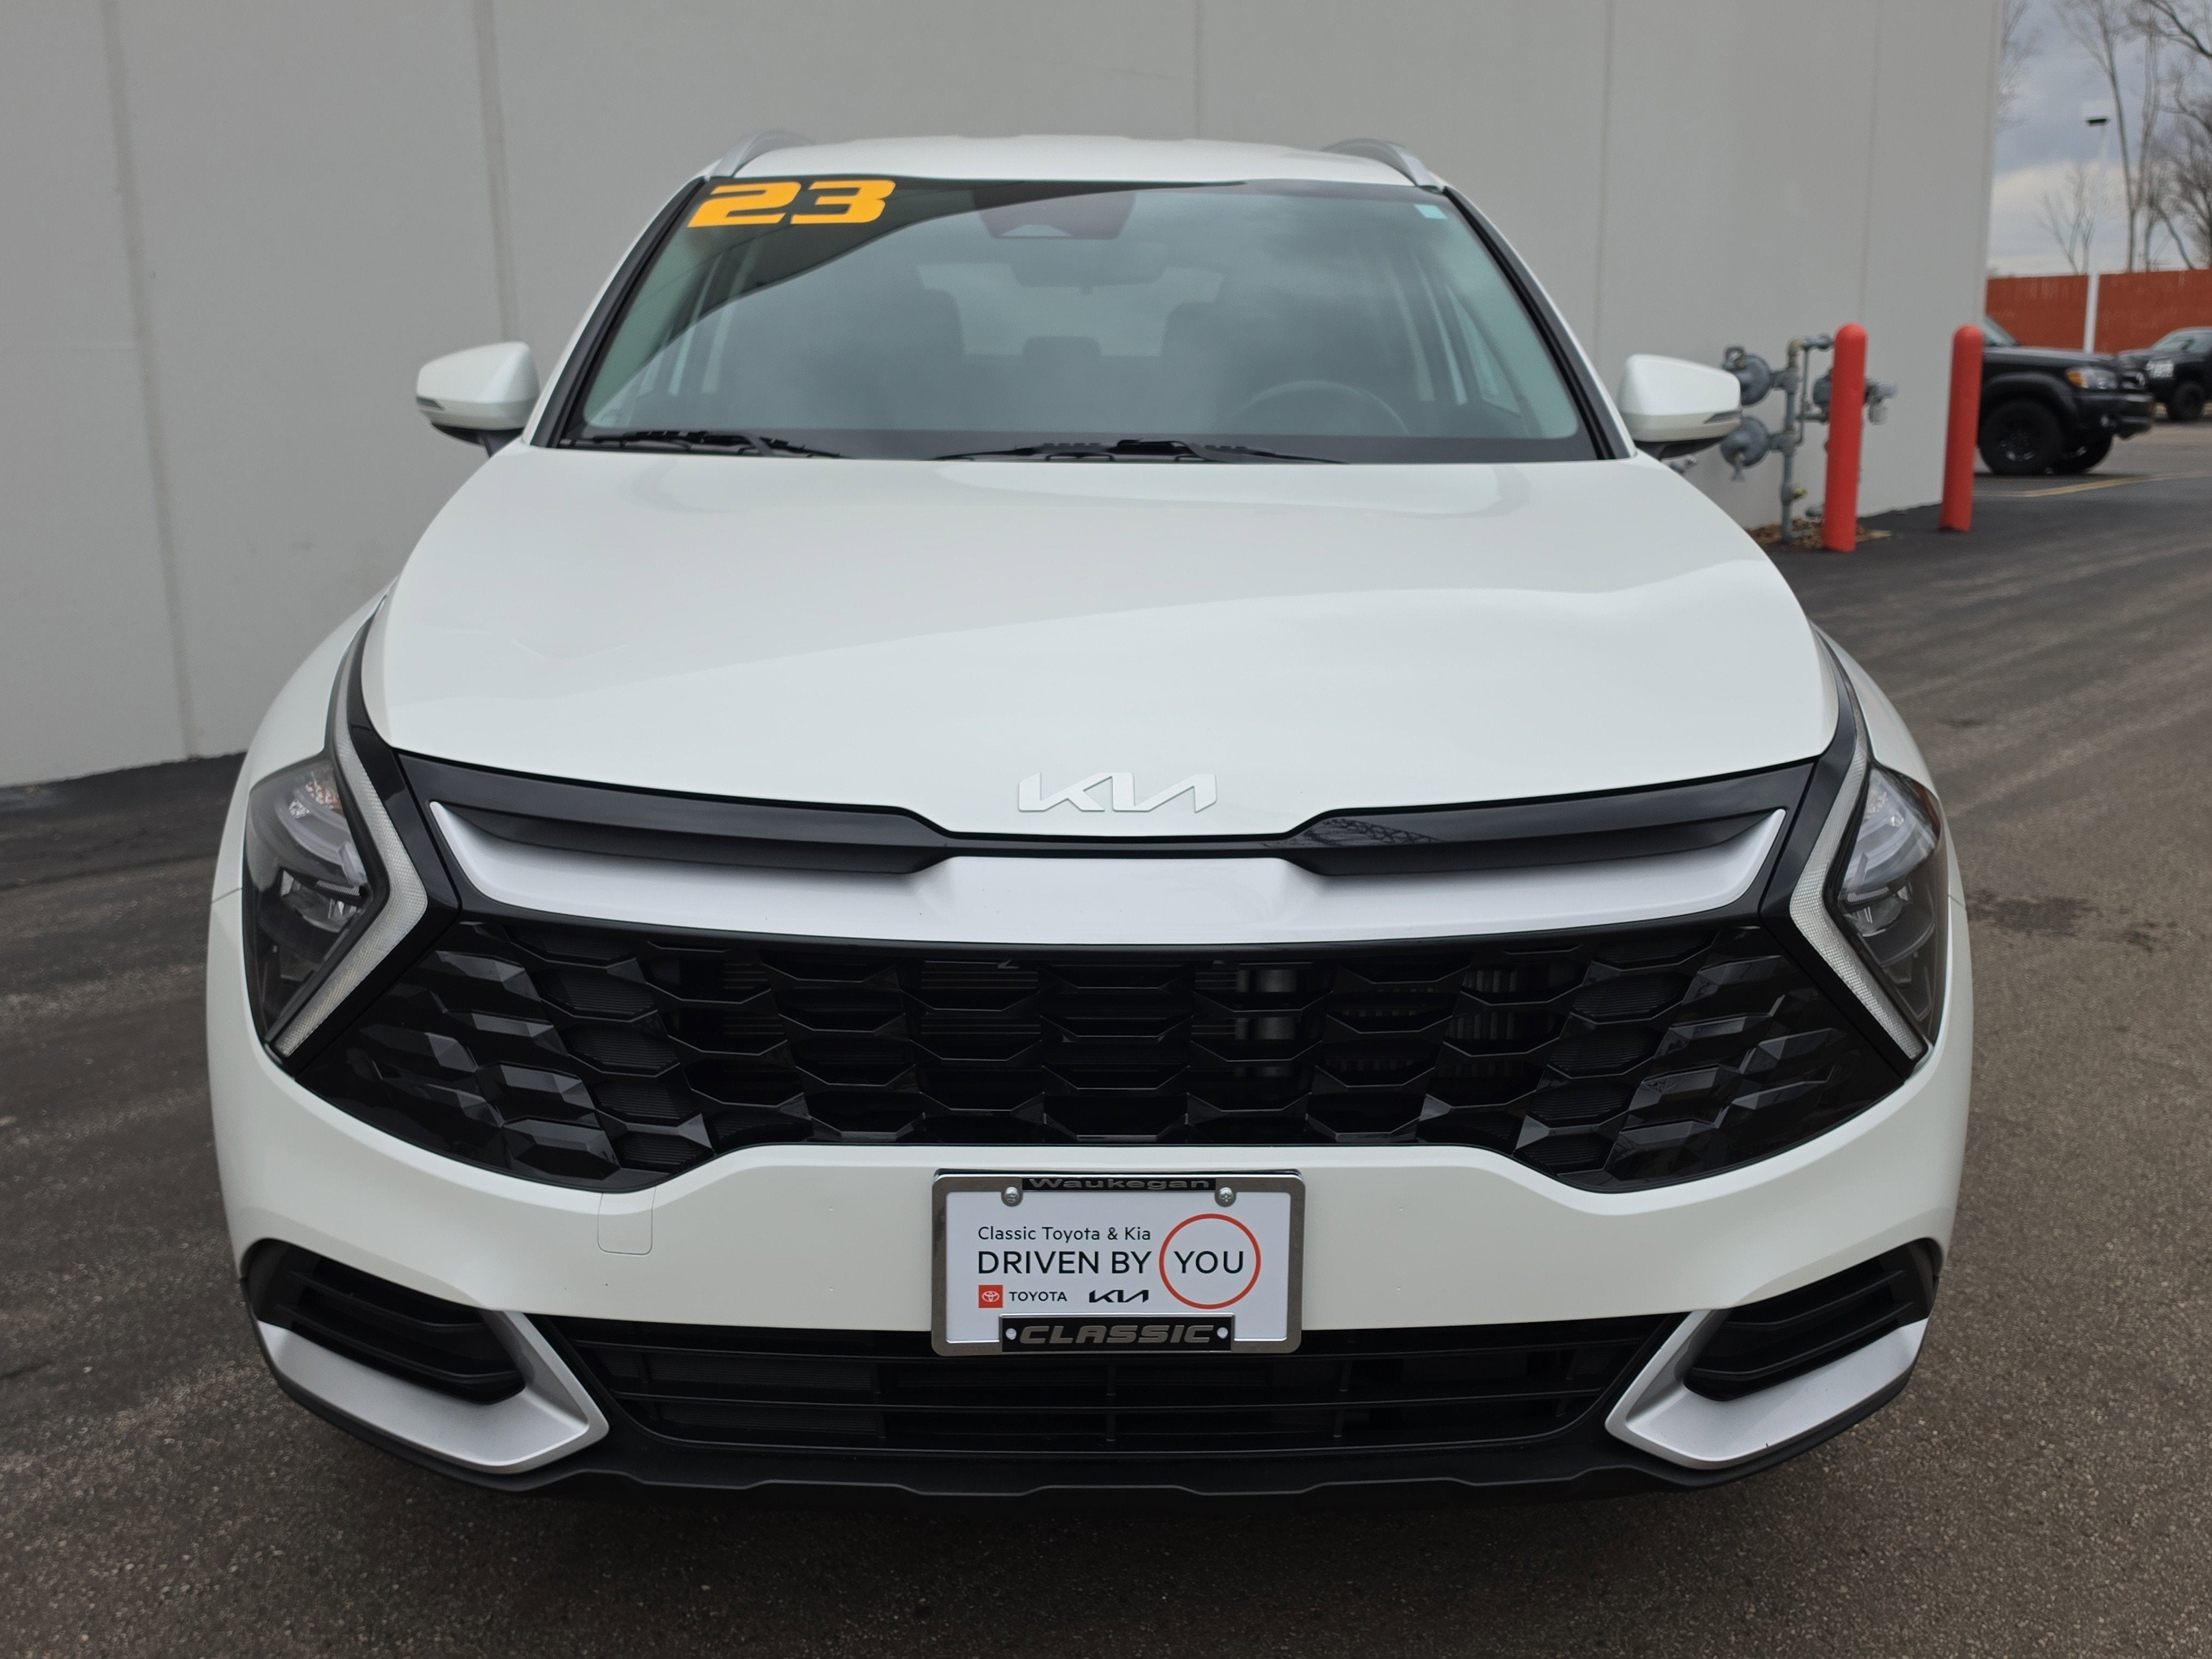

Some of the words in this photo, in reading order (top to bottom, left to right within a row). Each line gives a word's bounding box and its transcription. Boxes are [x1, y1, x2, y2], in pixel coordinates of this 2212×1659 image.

[687, 179, 896, 228] 23
[1029, 1179, 1210, 1189] Waukegan
[978, 1226, 1036, 1241] Classic
[1041, 1226, 1101, 1244] Toyota
[1107, 1227, 1118, 1241] &
[1125, 1226, 1151, 1241] Kia
[978, 1251, 1099, 1274] DRIVEN
[1111, 1251, 1152, 1274] BY
[1174, 1251, 1244, 1274] YOU
[1009, 1291, 1068, 1302] TOYOTA
[1019, 1325, 1214, 1345] CLASSIC
